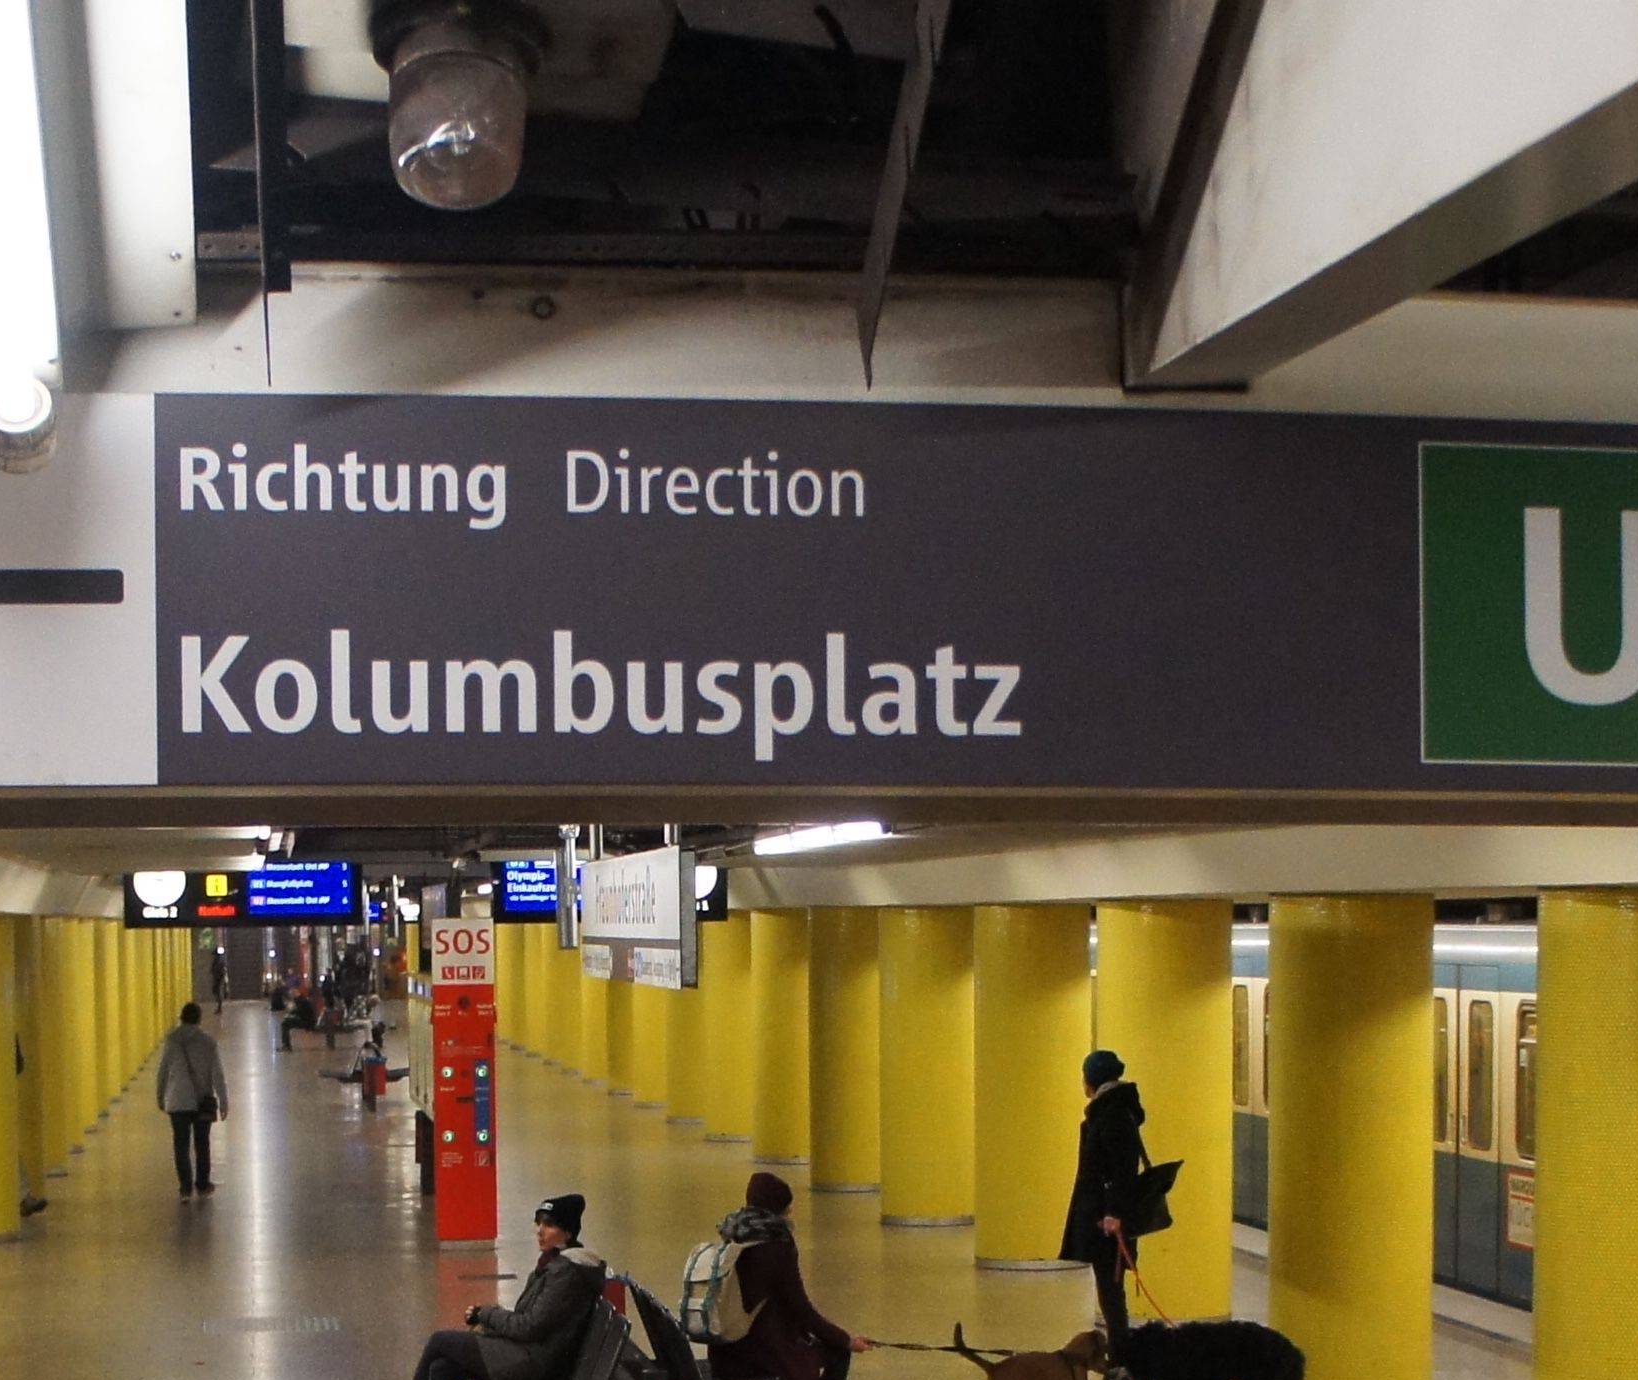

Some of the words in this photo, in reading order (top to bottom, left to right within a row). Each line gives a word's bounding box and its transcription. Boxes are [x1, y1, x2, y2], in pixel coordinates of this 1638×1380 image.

[179, 443, 507, 530] Richtung
[566, 448, 865, 518] Direction
[179, 628, 1022, 762] Kolumbusplatz
[435, 929, 491, 955] SOS
